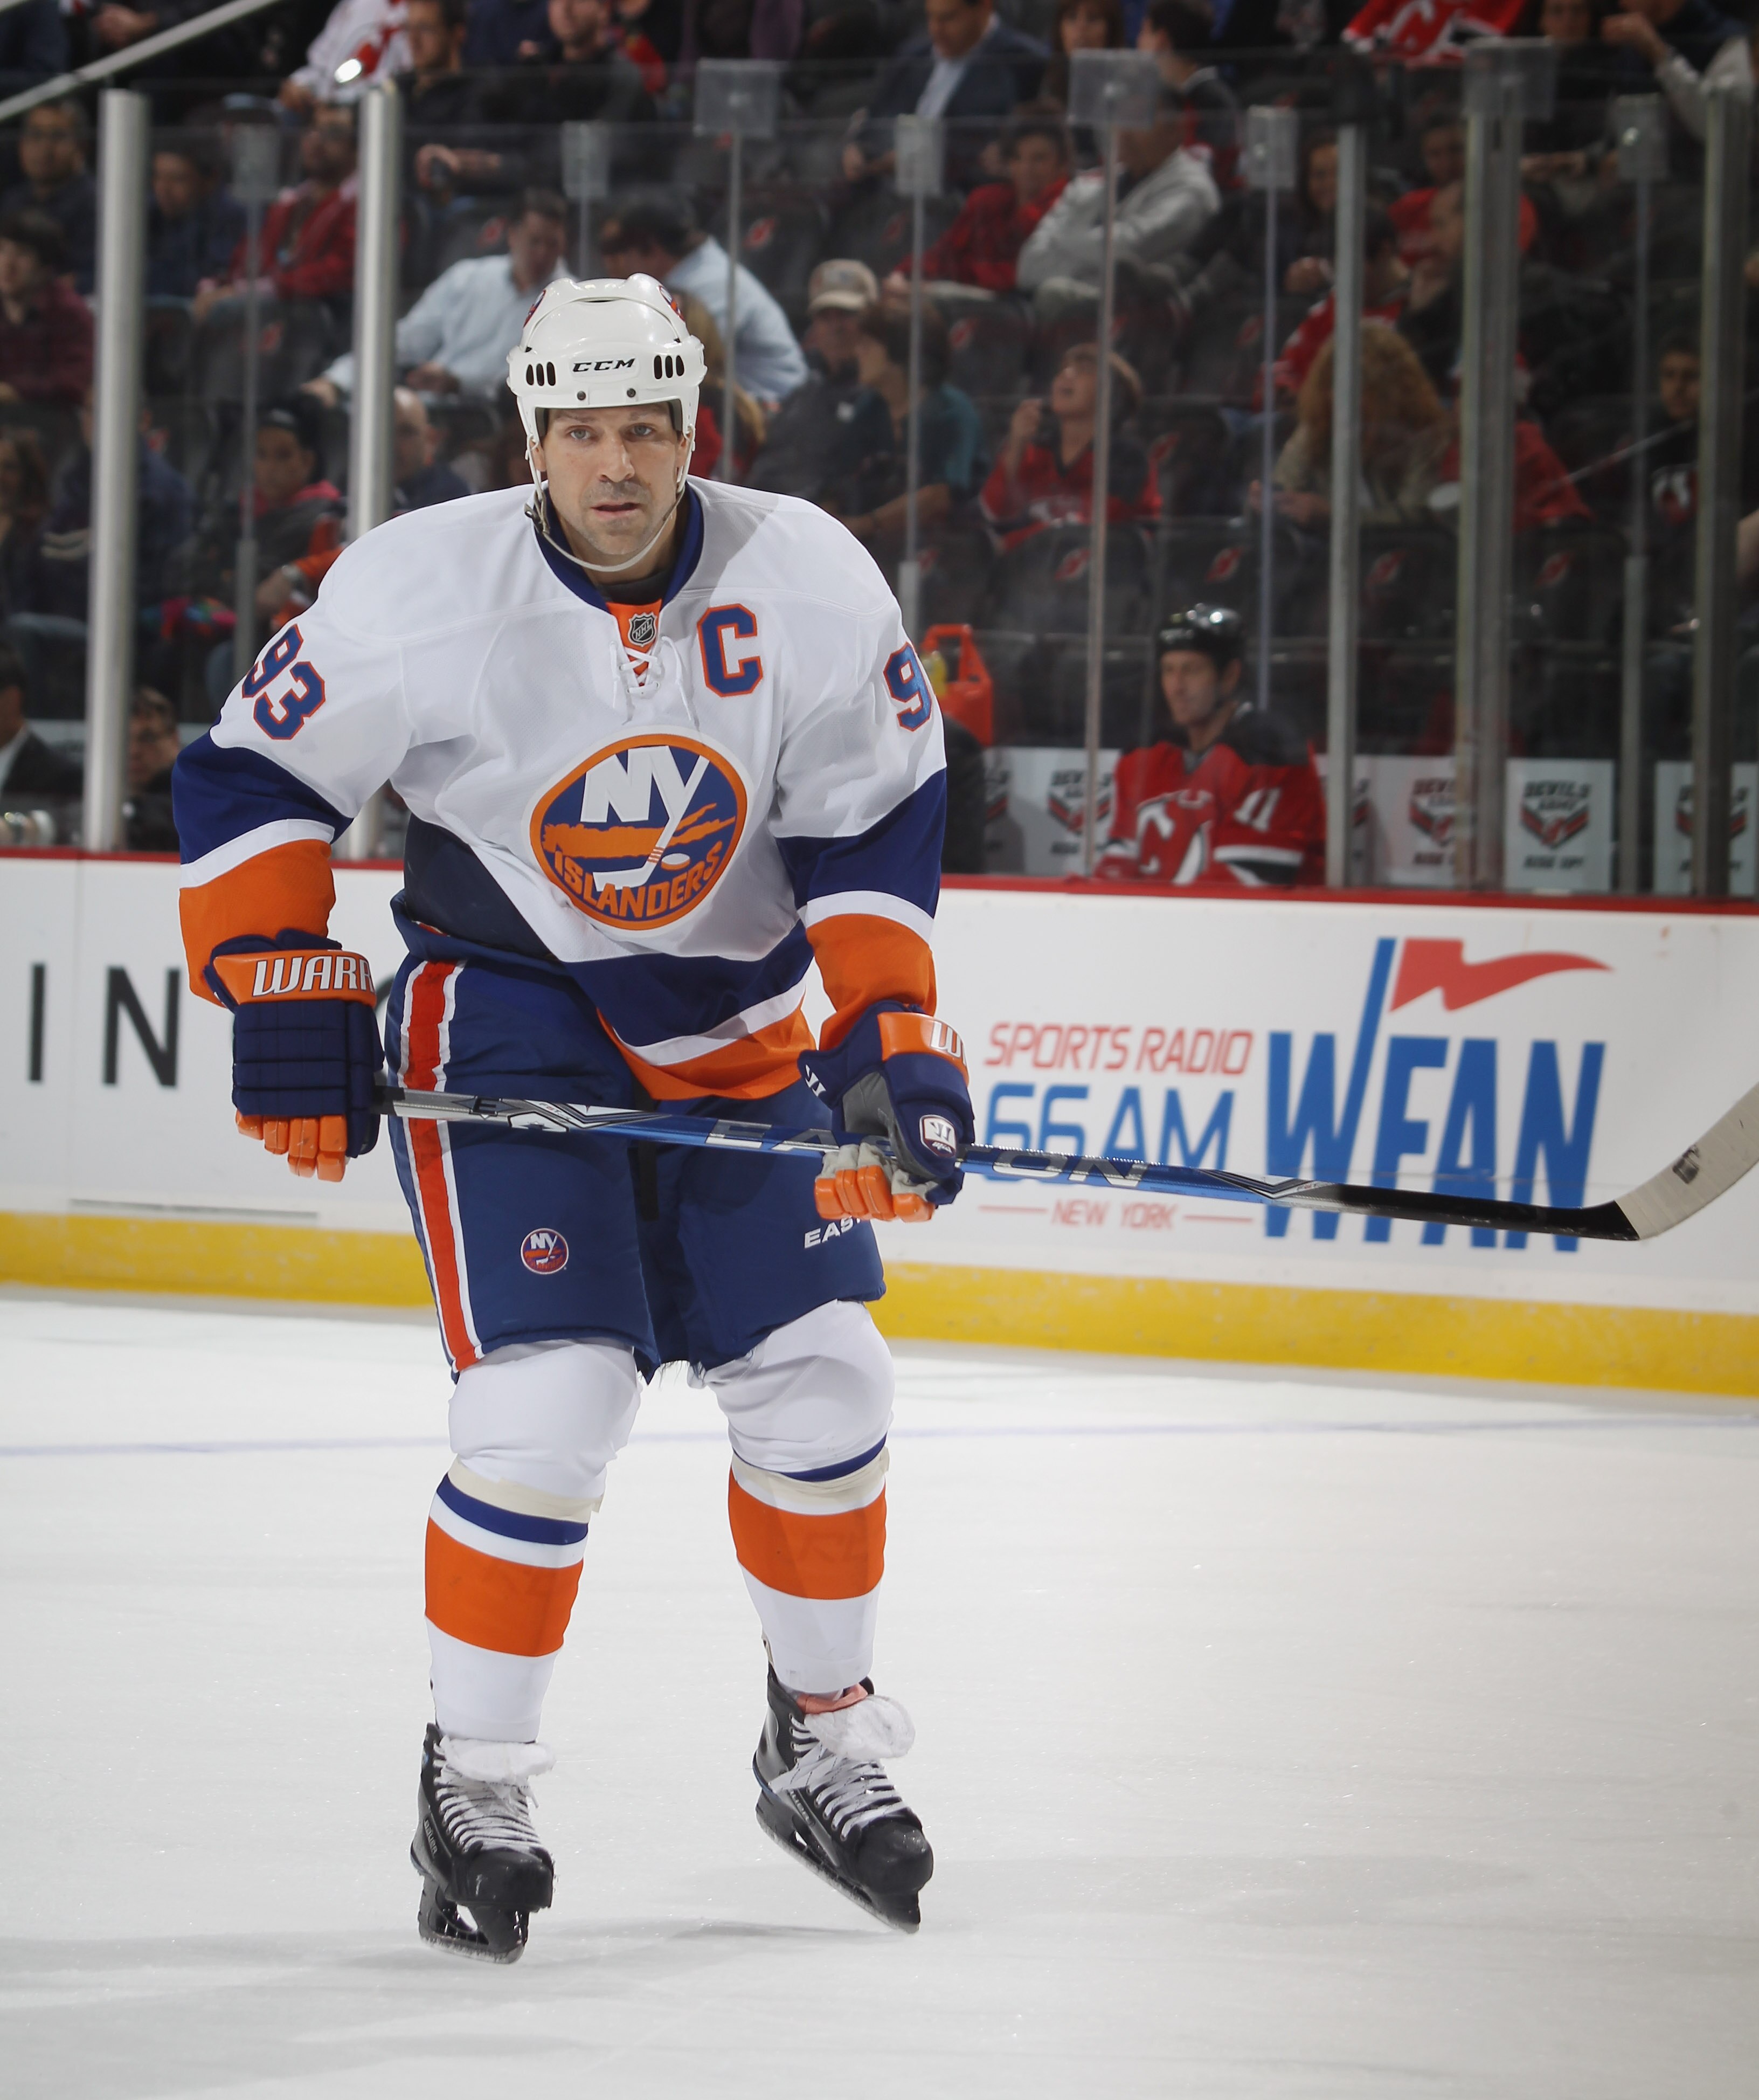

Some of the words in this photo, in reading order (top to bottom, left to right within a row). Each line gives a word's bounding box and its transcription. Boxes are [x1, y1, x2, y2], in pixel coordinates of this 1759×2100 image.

[572, 357, 635, 372] CCM
[635, 620, 650, 639] NHL
[697, 604, 763, 698] C
[241, 623, 326, 740] 93
[580, 745, 710, 824] NY
[1232, 786, 1281, 833] 11
[554, 841, 723, 918] ISLANDERS
[930, 1019, 968, 1067] W
[984, 1021, 1134, 1070] SPORTS
[1134, 1027, 1255, 1075] RADIO
[1265, 937, 1606, 1253] WFAN
[982, 1082, 1090, 1184] 66
[1102, 1086, 1235, 1173] AM
[804, 1215, 861, 1249] EAS
[1051, 1199, 1109, 1227] NEW
[1121, 1201, 1179, 1230] YORK
